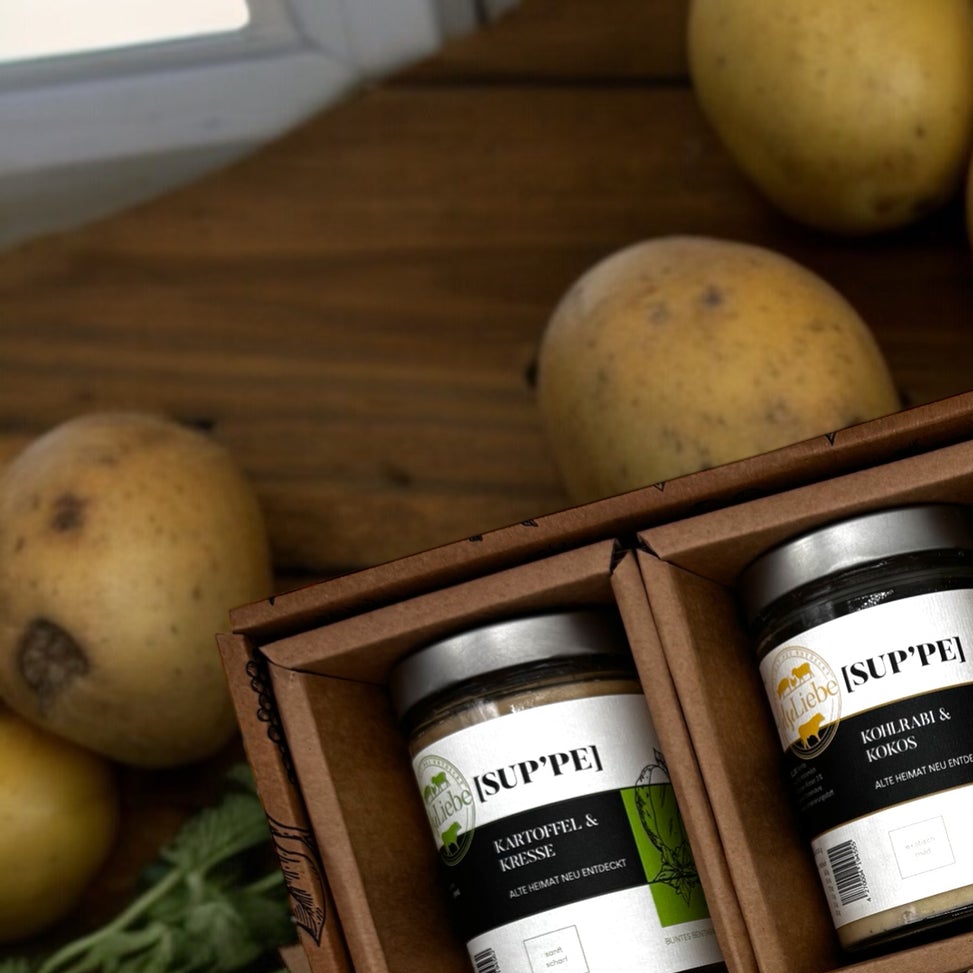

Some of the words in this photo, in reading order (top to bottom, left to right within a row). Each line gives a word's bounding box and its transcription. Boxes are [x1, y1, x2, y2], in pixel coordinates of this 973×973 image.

[860, 710, 936, 744] KOHLRABI
[939, 707, 951, 721] &
[866, 735, 918, 763] KOKOS
[874, 775, 895, 790] ALTE
[896, 766, 927, 782] HEIMAT
[928, 760, 947, 774] NEU
[494, 818, 582, 854] KARTOFFEL
[585, 813, 599, 828] &
[500, 844, 556, 872] KRESSE
[509, 886, 528, 899] ALTE
[528, 875, 561, 892] HEIMAT
[561, 870, 581, 883] NEU
[582, 858, 627, 877] ENTDECKT
